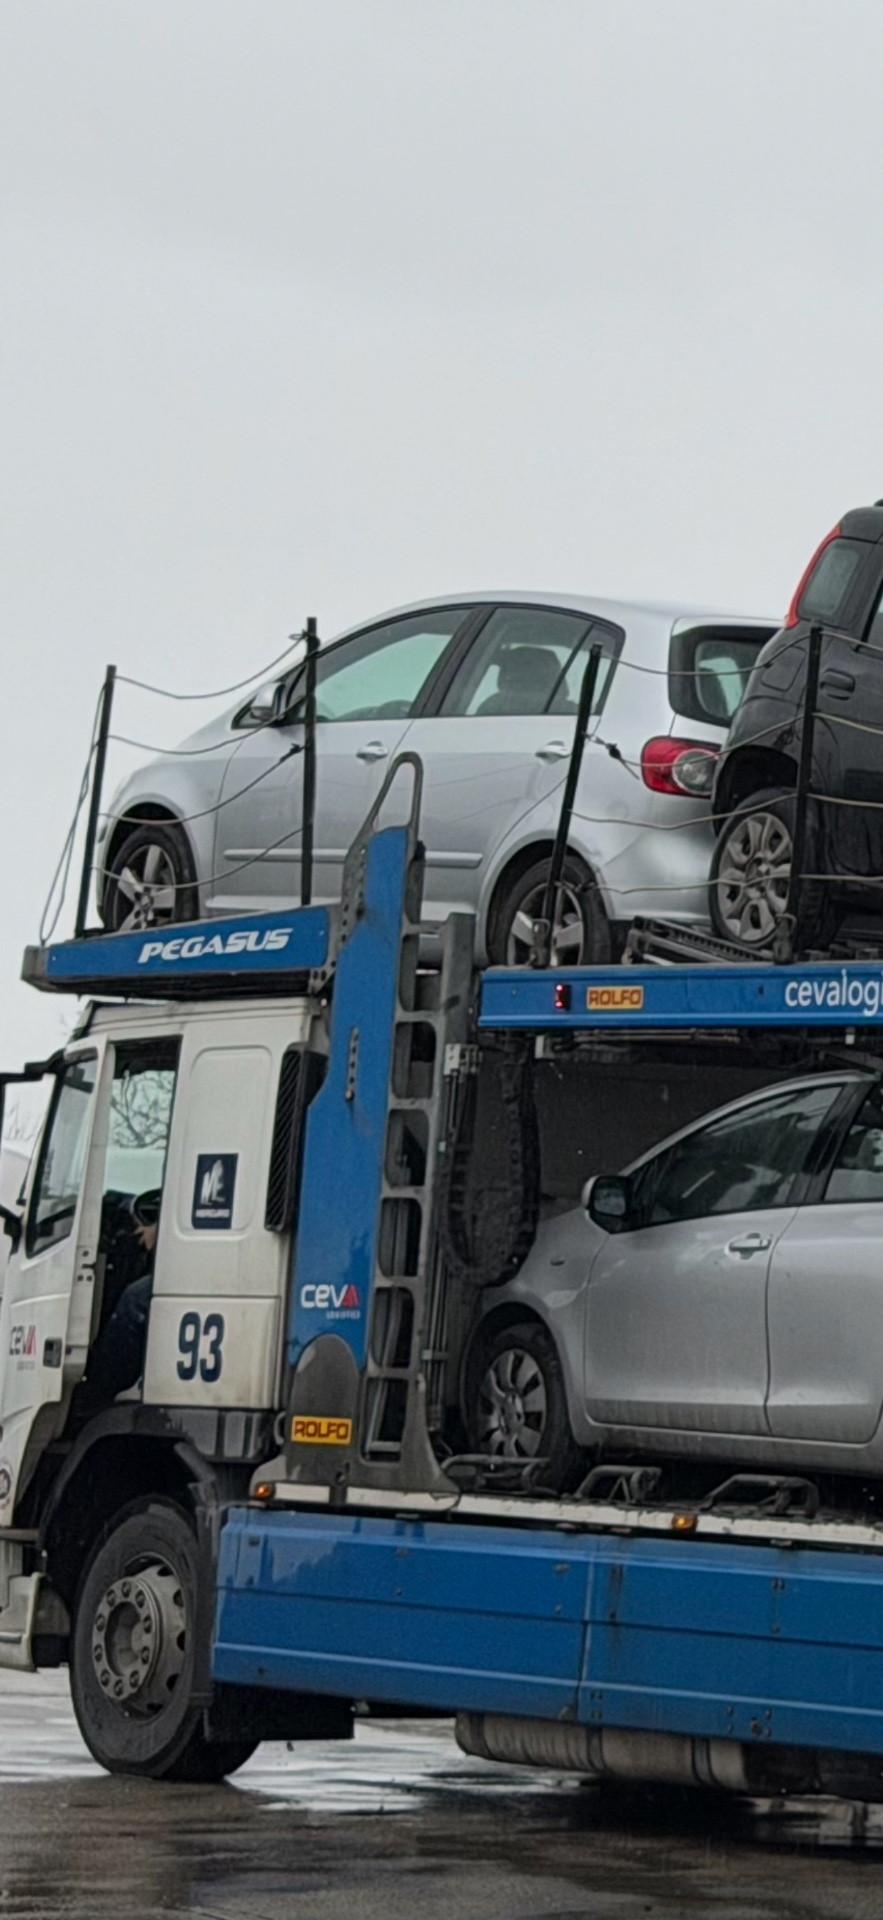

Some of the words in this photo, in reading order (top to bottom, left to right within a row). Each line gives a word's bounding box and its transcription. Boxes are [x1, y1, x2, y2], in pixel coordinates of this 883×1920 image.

[138, 928, 293, 964] PEGASUS
[589, 989, 641, 1005] ROLFO
[177, 1312, 224, 1382] 93
[295, 1421, 349, 1440] ROLFO
